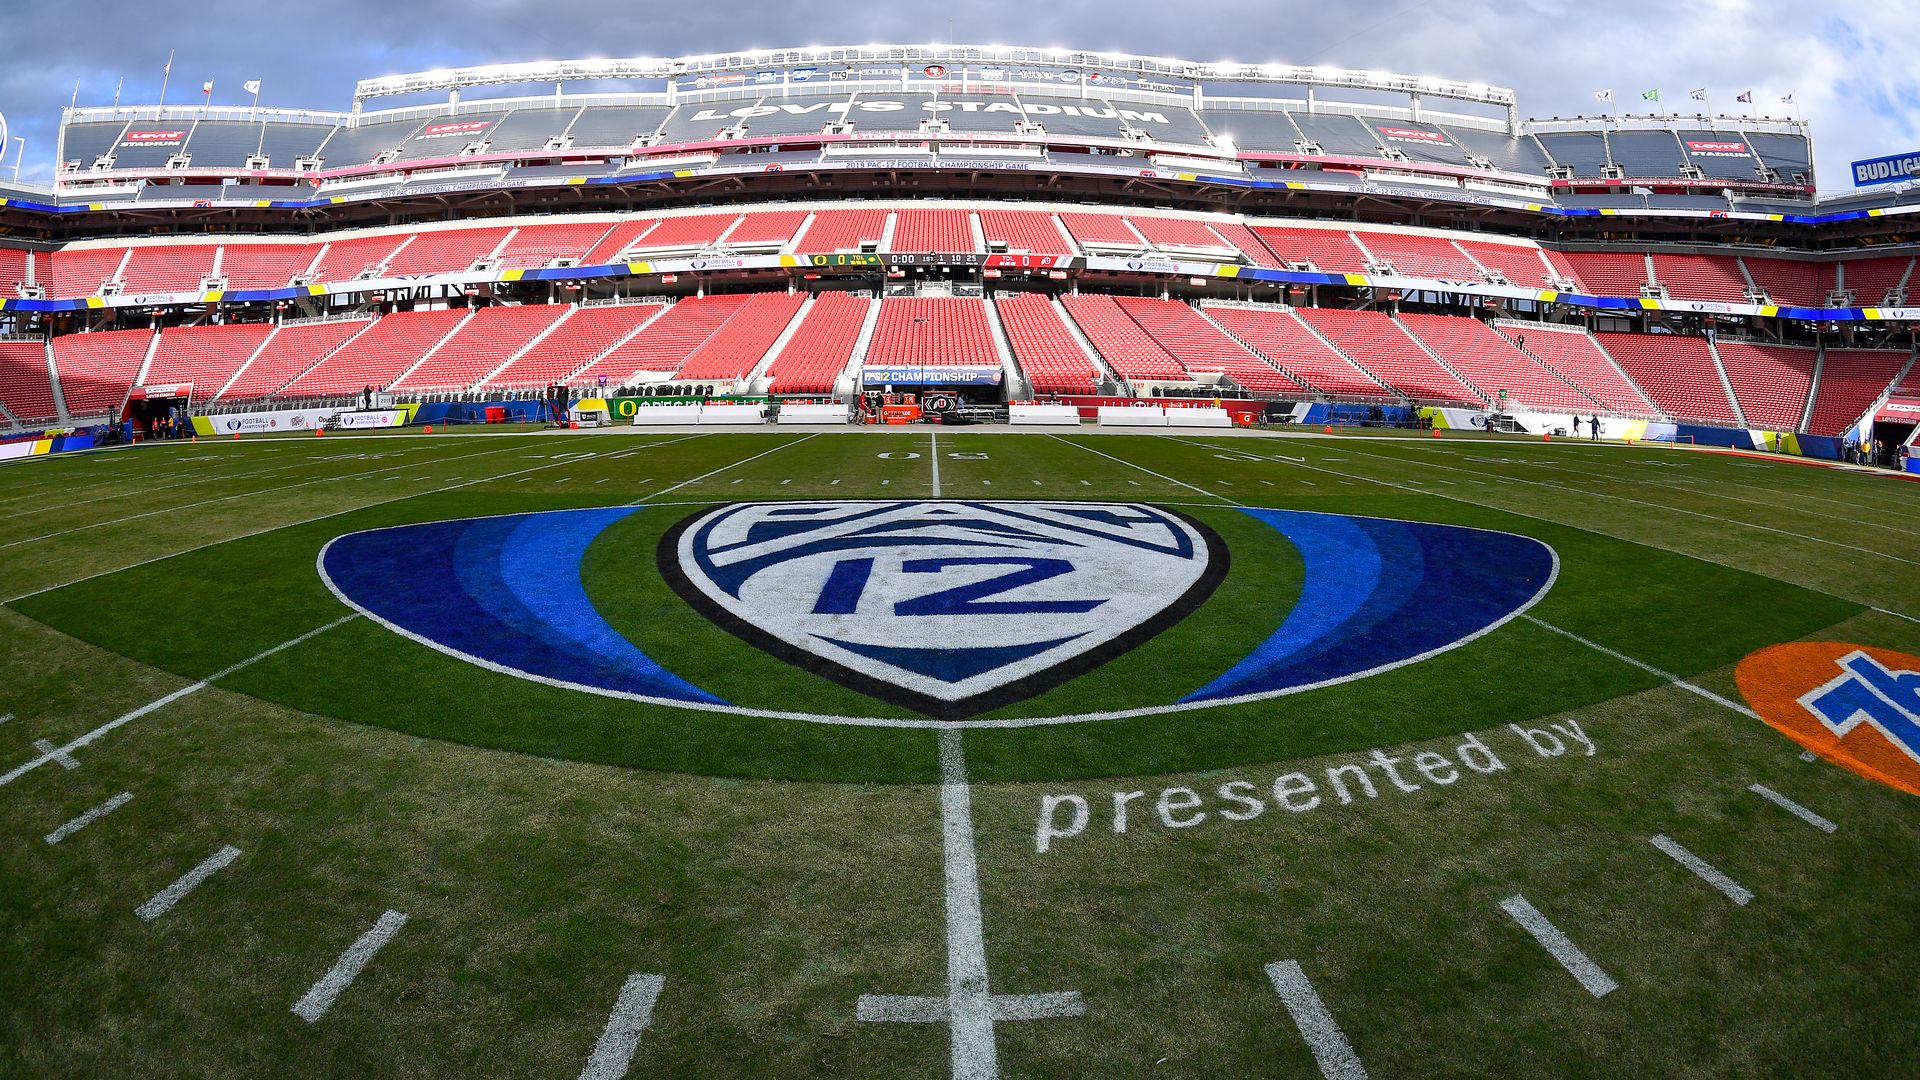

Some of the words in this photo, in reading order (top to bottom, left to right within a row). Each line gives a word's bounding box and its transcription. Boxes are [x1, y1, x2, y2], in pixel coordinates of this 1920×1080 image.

[831, 71, 847, 79] nrg
[922, 101, 1170, 124] STADIUM
[419, 186, 451, 194] FOOTBALL
[453, 182, 505, 191] CHAMPIONSHIP
[1390, 189, 1422, 197] FOOTBALL
[1423, 192, 1473, 202] CHAMPIONSHIP
[1473, 197, 1491, 205] GAME
[838, 255, 846, 265] 0
[891, 255, 915, 263] 0:00
[1022, 256, 1030, 266] 0
[891, 372, 978, 381] CHAMPIONSHIP
[811, 556, 1110, 616] 12
[1035, 731, 1508, 853] presented
[1508, 708, 1597, 758] by
